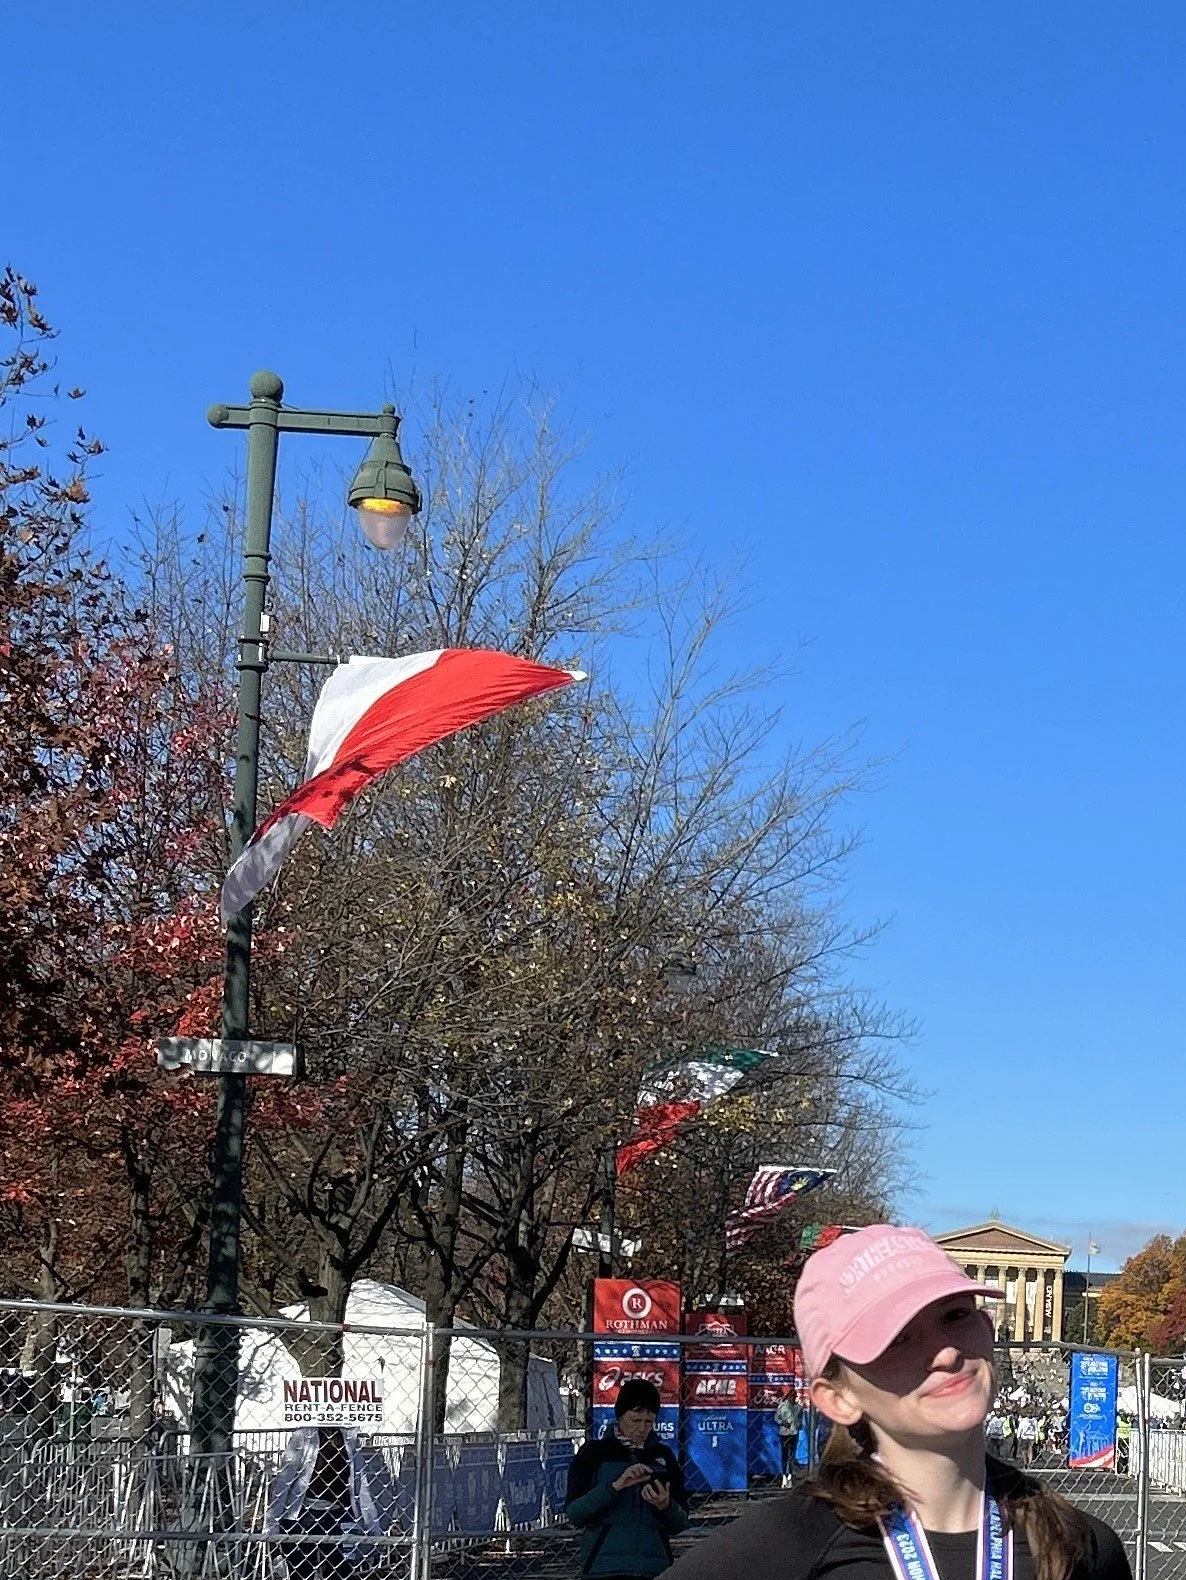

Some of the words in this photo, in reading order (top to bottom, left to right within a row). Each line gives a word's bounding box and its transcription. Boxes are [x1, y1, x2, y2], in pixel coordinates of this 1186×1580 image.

[632, 1298, 643, 1309] R
[606, 1319, 668, 1330] ROTHMAN
[283, 1380, 383, 1403] NATIONAL
[695, 1379, 737, 1395] ACME
[284, 1403, 383, 1412] RENT-A-FENCE
[284, 1413, 383, 1422] 800-352-5675
[698, 1421, 734, 1431] ULTRA
[896, 1533, 918, 1560] 2023
